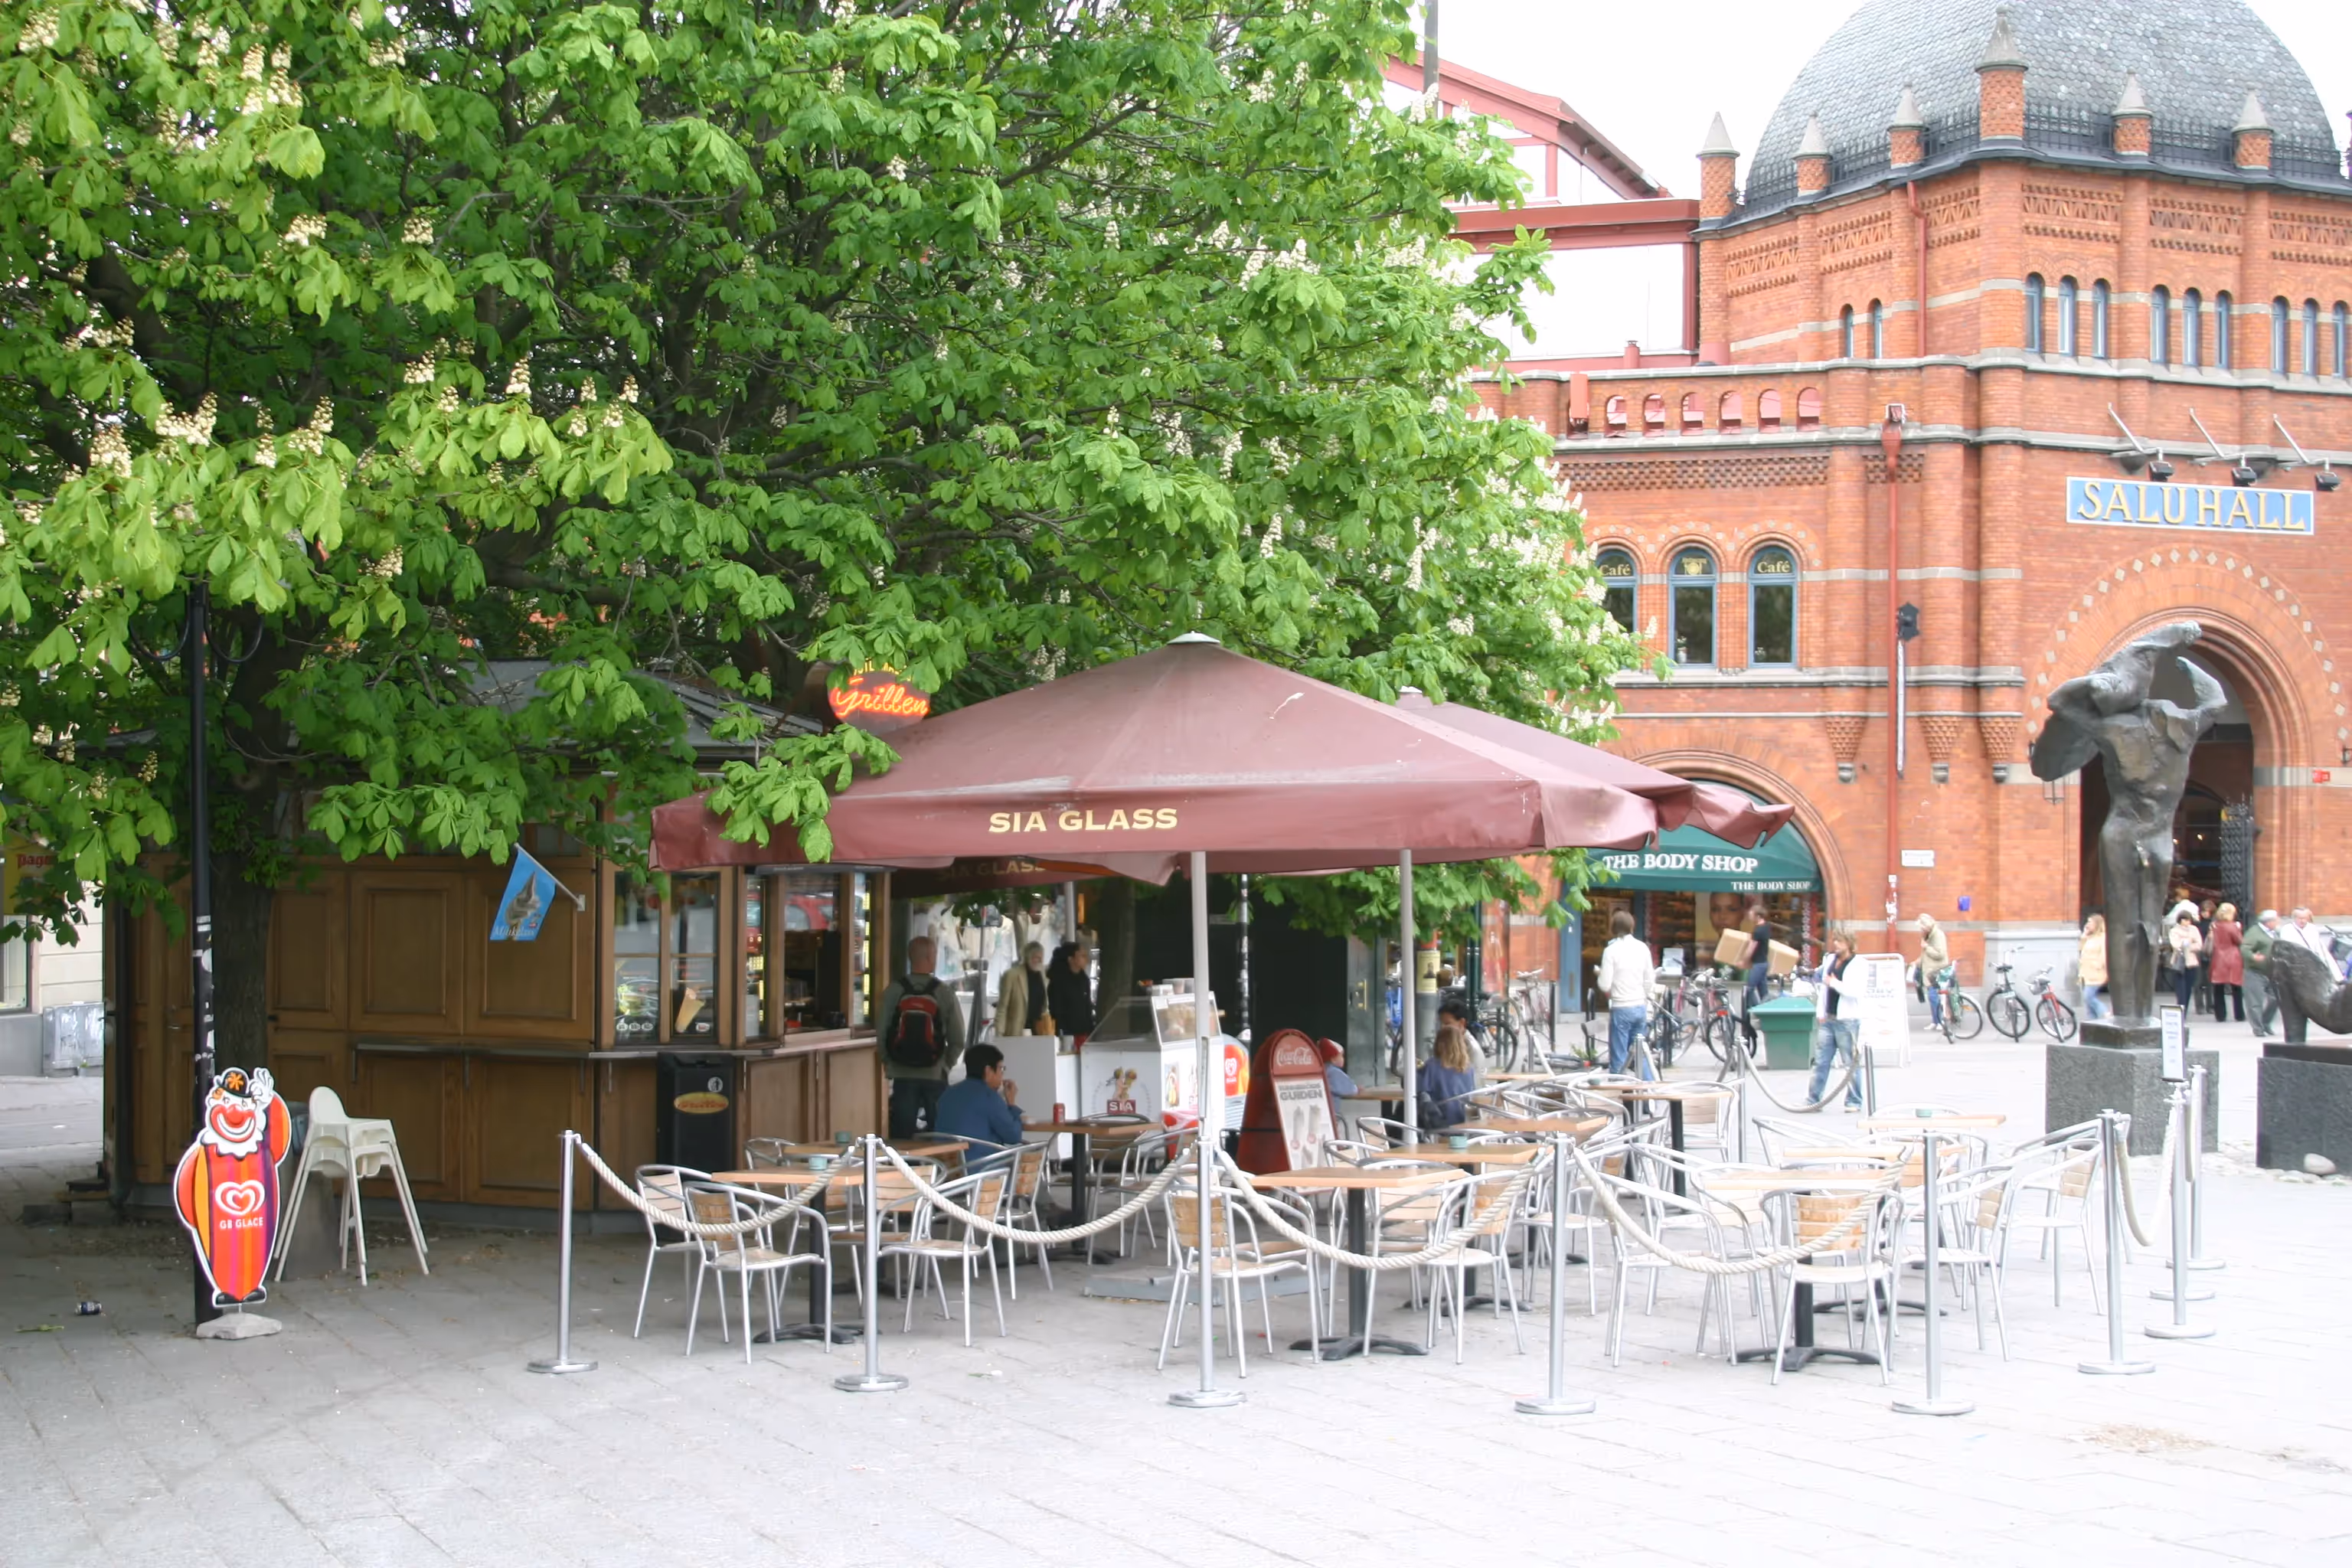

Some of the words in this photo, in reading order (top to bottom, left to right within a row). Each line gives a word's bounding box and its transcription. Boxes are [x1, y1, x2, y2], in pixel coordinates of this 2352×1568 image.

[2077, 482, 2305, 530] SALUHALL
[1599, 564, 1631, 576] Café
[1757, 560, 1790, 573] Café
[988, 812, 1047, 832] SIA
[1059, 808, 1178, 831] GLASS
[1602, 854, 1640, 869] THE
[1644, 854, 1700, 870] BODY
[1702, 855, 1758, 873] SHOP
[1730, 881, 1755, 890] THE
[1757, 881, 1786, 890] BODY
[1787, 881, 1811, 890] SHOP
[1279, 1089, 1323, 1101] GUIDEN
[1109, 1101, 1134, 1111] SIA
[235, 1217, 264, 1228] GLACE
